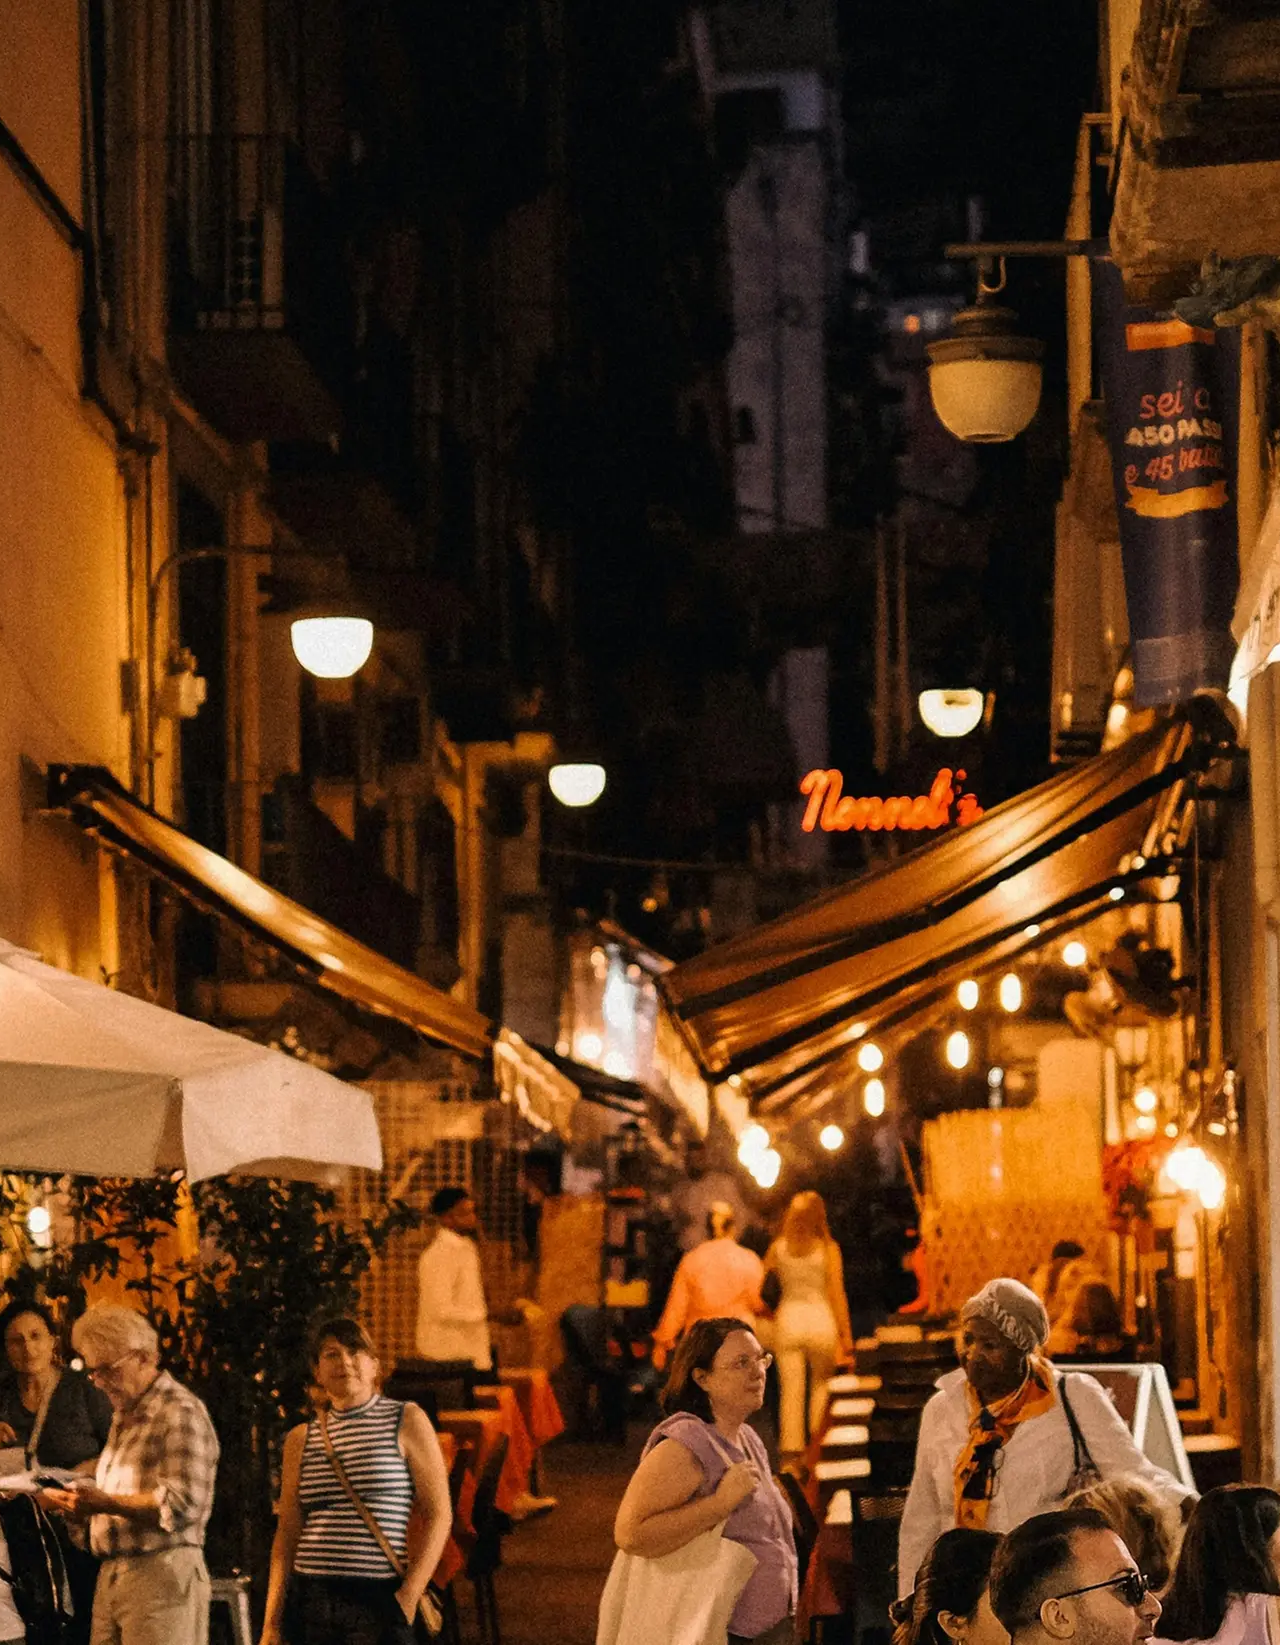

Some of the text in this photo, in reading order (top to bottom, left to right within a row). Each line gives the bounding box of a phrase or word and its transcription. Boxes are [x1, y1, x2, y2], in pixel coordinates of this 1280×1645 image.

[1140, 380, 1184, 419] sei
[1124, 464, 1138, 485] e
[1145, 454, 1174, 482] 45
